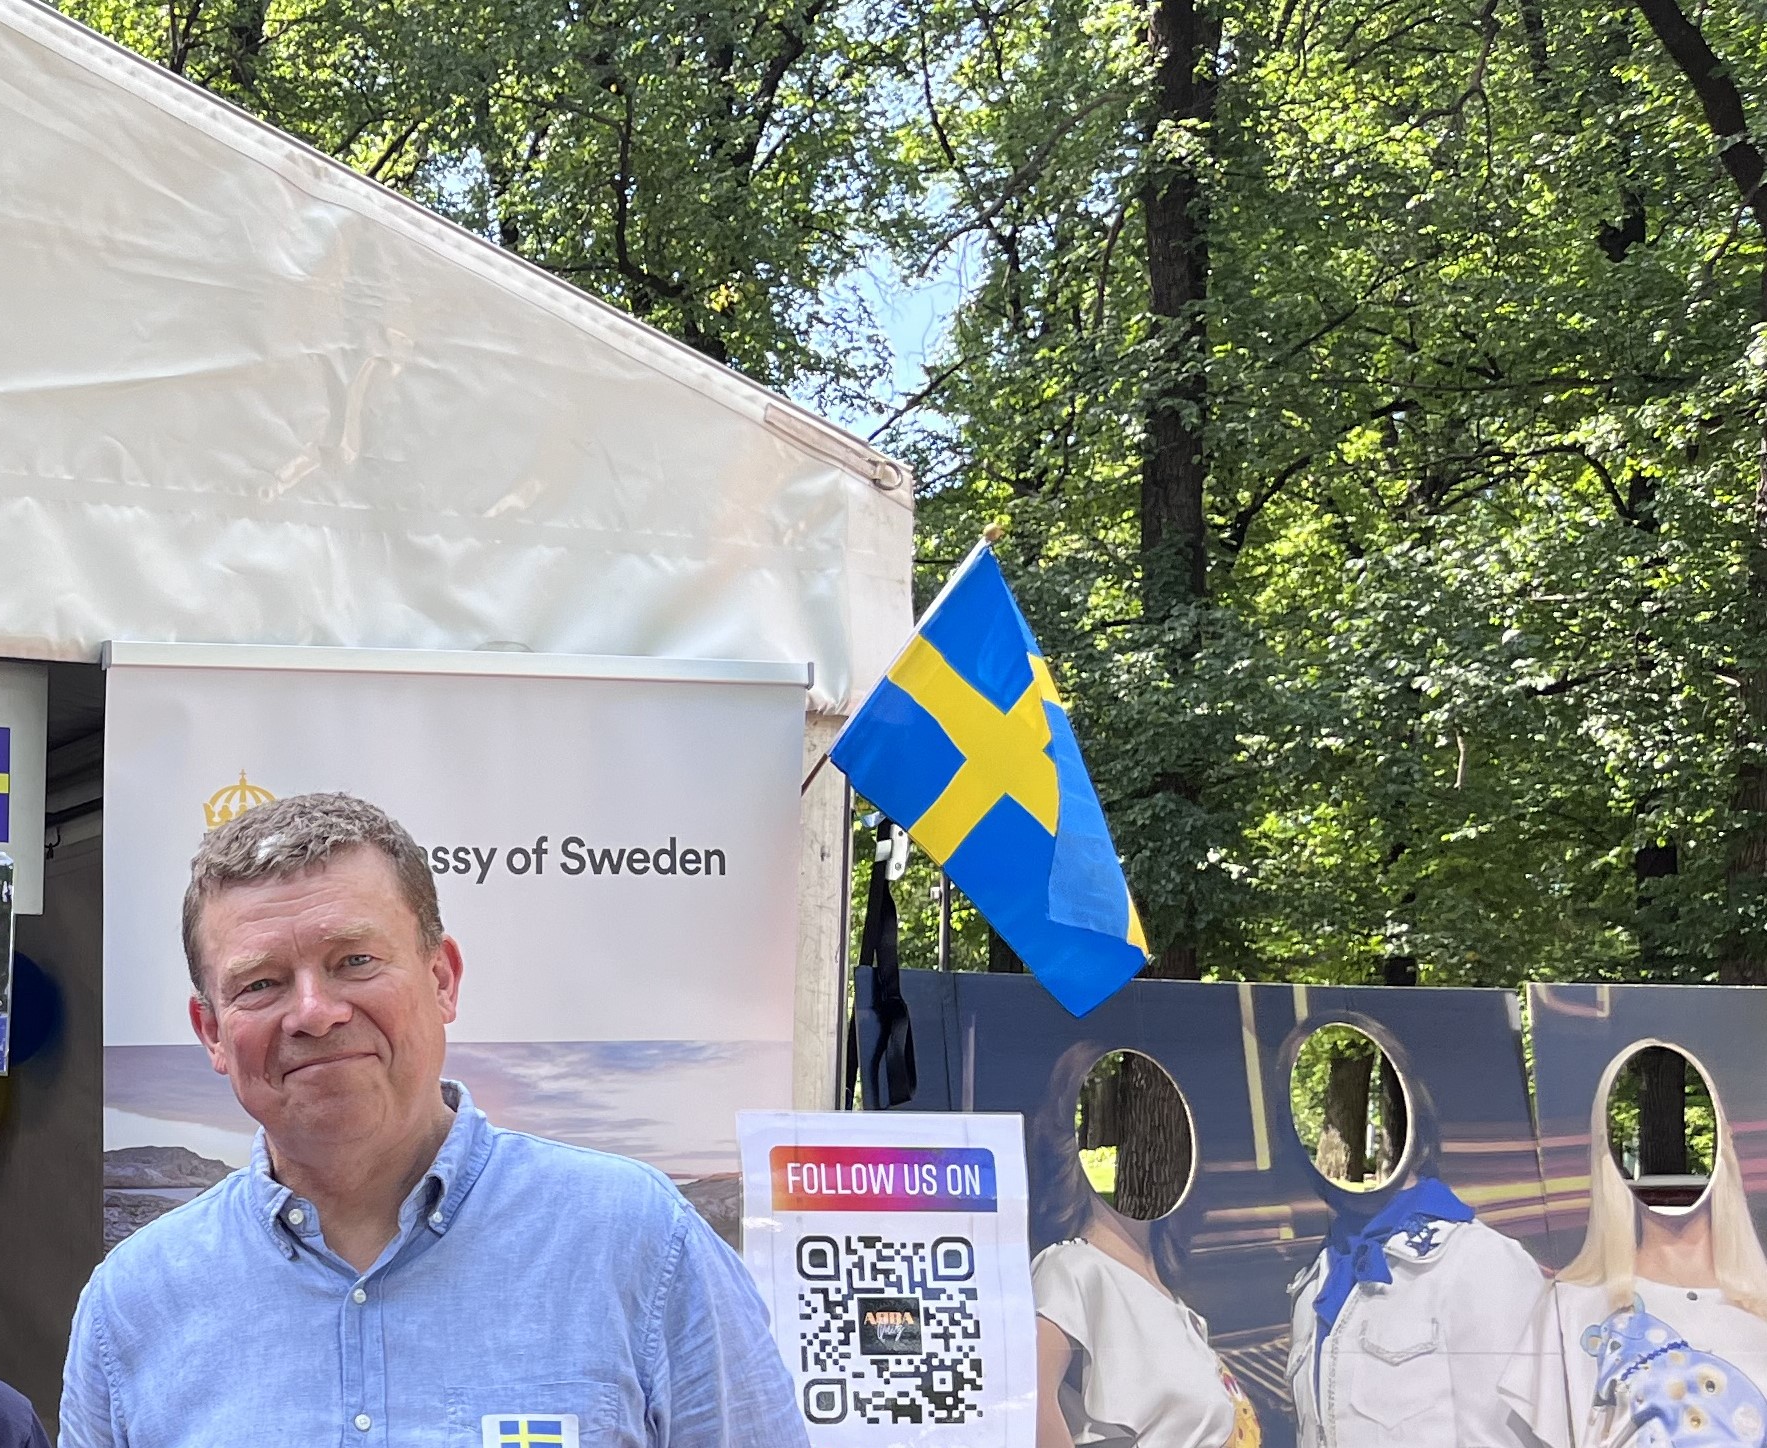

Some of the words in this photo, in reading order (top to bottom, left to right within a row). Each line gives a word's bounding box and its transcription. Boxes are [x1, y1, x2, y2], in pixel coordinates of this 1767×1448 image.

[506, 836, 548, 875] of
[560, 836, 726, 876] Sweden
[787, 1162, 894, 1195] FOLLOW
[903, 1163, 938, 1195] US
[946, 1164, 981, 1196] ON
